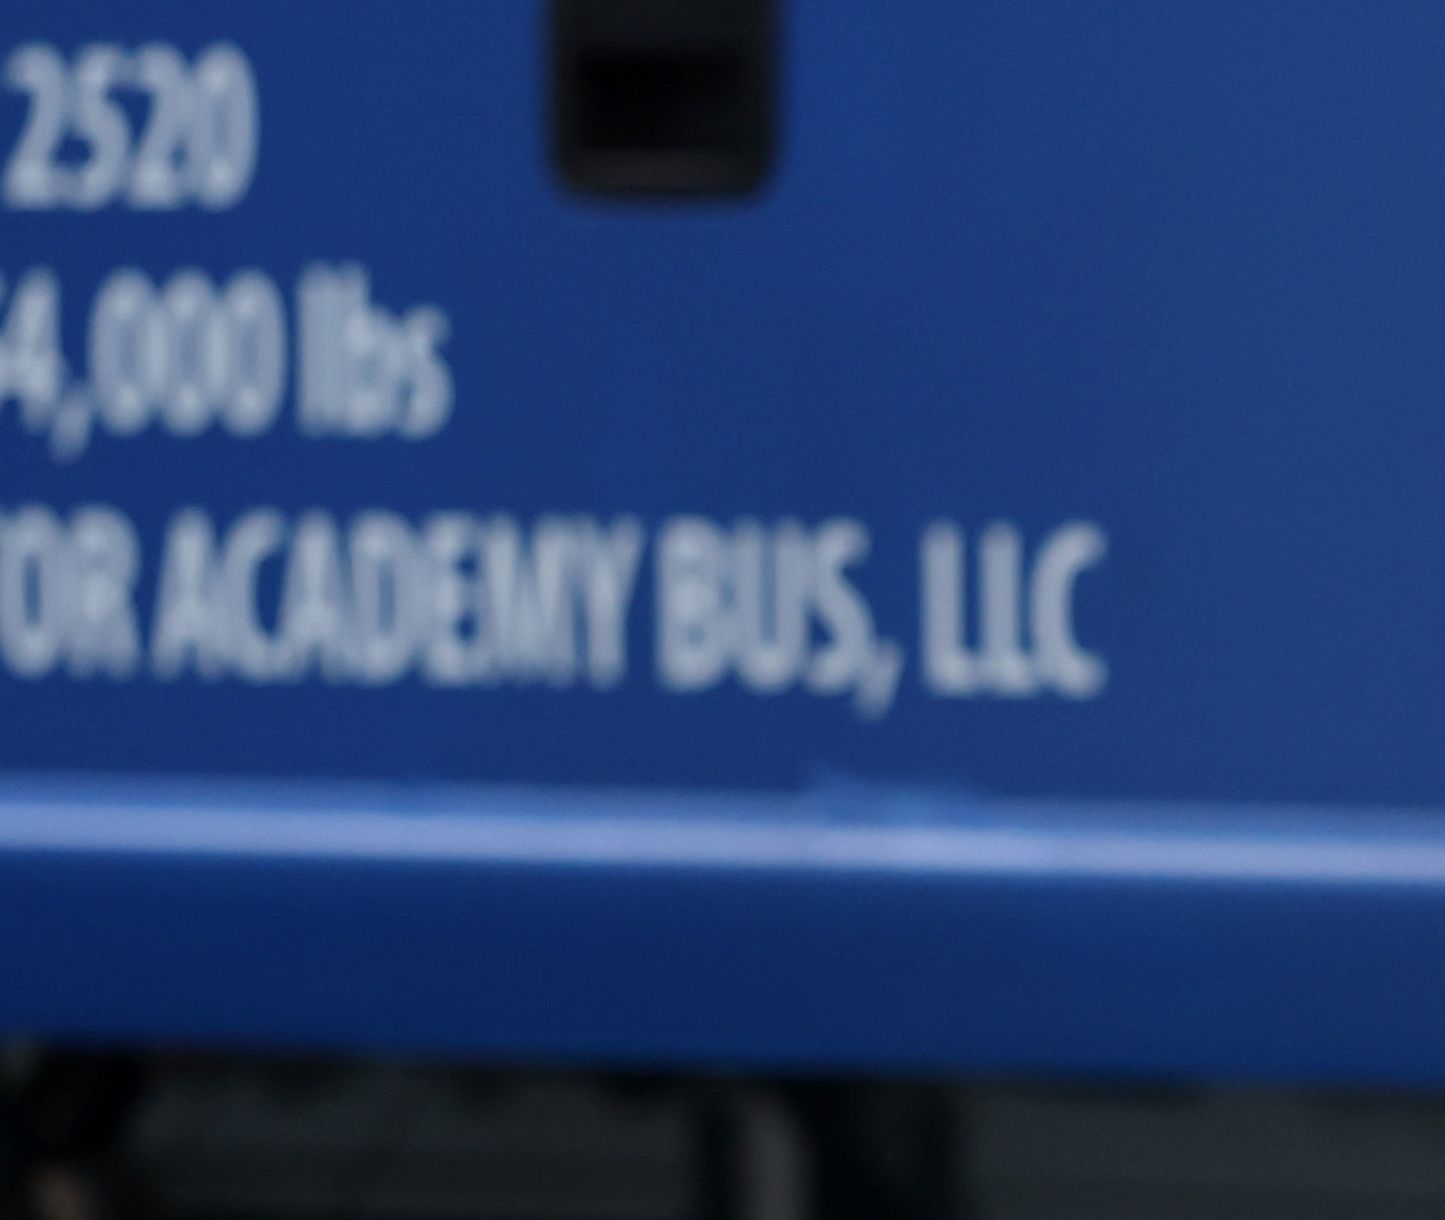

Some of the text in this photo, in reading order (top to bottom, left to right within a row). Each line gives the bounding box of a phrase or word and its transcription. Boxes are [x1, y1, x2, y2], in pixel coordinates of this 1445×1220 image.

[4, 44, 257, 208] 2520
[0, 263, 453, 458] 4,000 lbs
[0, 507, 1107, 720] OR ACADEMY BUS, LLC
